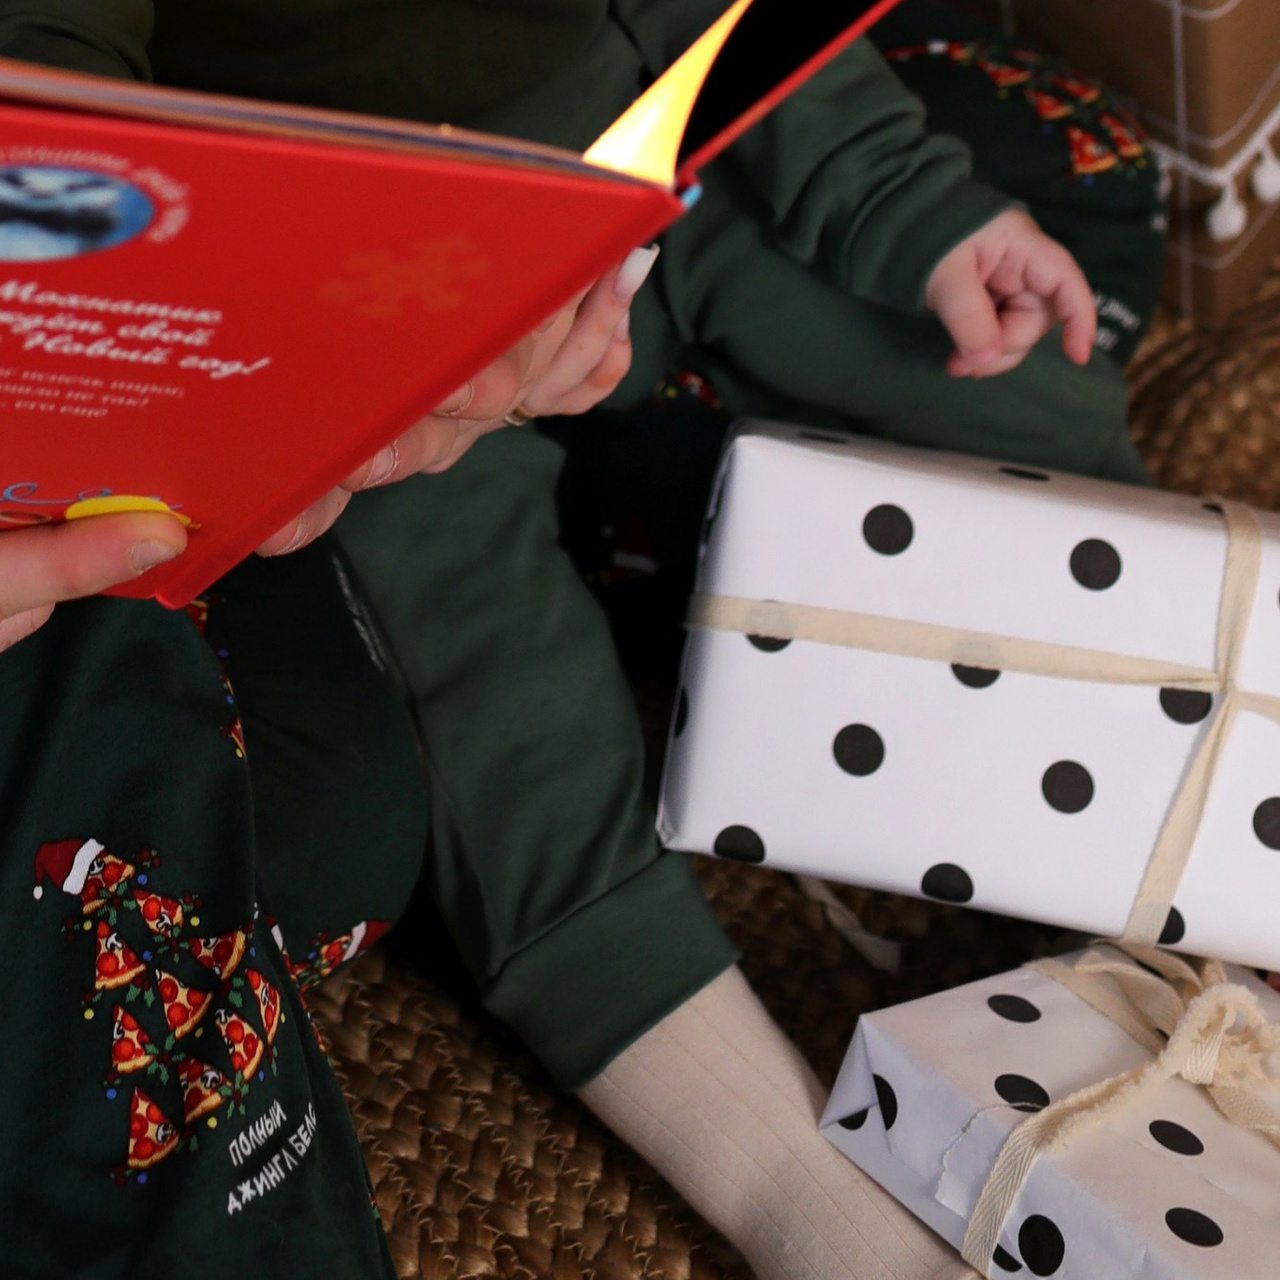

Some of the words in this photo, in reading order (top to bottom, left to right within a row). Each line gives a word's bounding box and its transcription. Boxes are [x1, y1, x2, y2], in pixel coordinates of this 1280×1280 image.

[23, 330, 168, 365] Новый
[178, 354, 272, 380] год!
[227, 1147, 299, 1216] ДЖИНГЛ
[288, 1101, 317, 1157] БЕЛС
[228, 1098, 287, 1167] ПОЛНЫЙ
